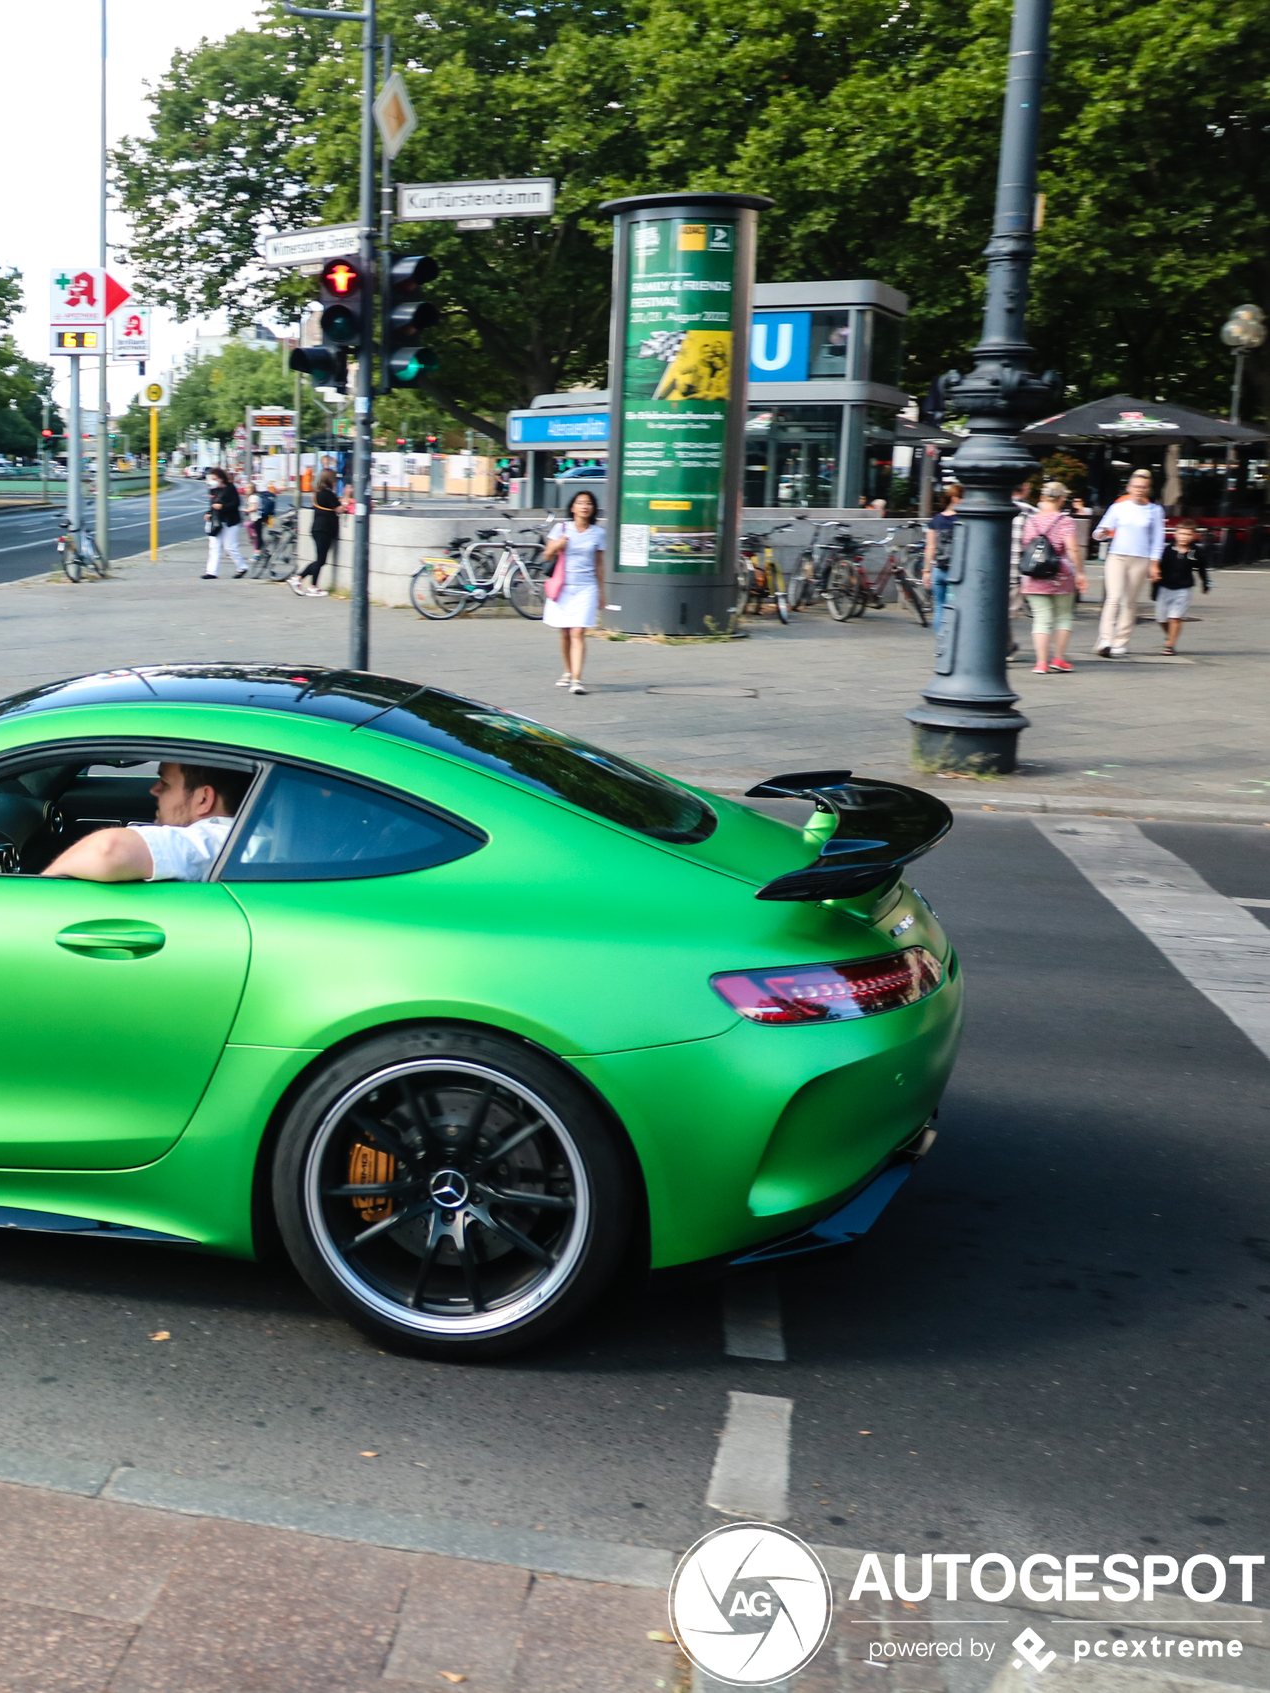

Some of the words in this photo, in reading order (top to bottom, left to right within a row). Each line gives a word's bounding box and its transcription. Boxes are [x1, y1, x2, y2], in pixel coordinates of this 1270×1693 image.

[407, 190, 543, 209] Kurfürstendamm
[632, 281, 670, 293] FAMILY
[683, 281, 732, 291] FRIENDS
[631, 296, 679, 308] FESTIVAL
[665, 312, 701, 323] August
[751, 323, 793, 371] U
